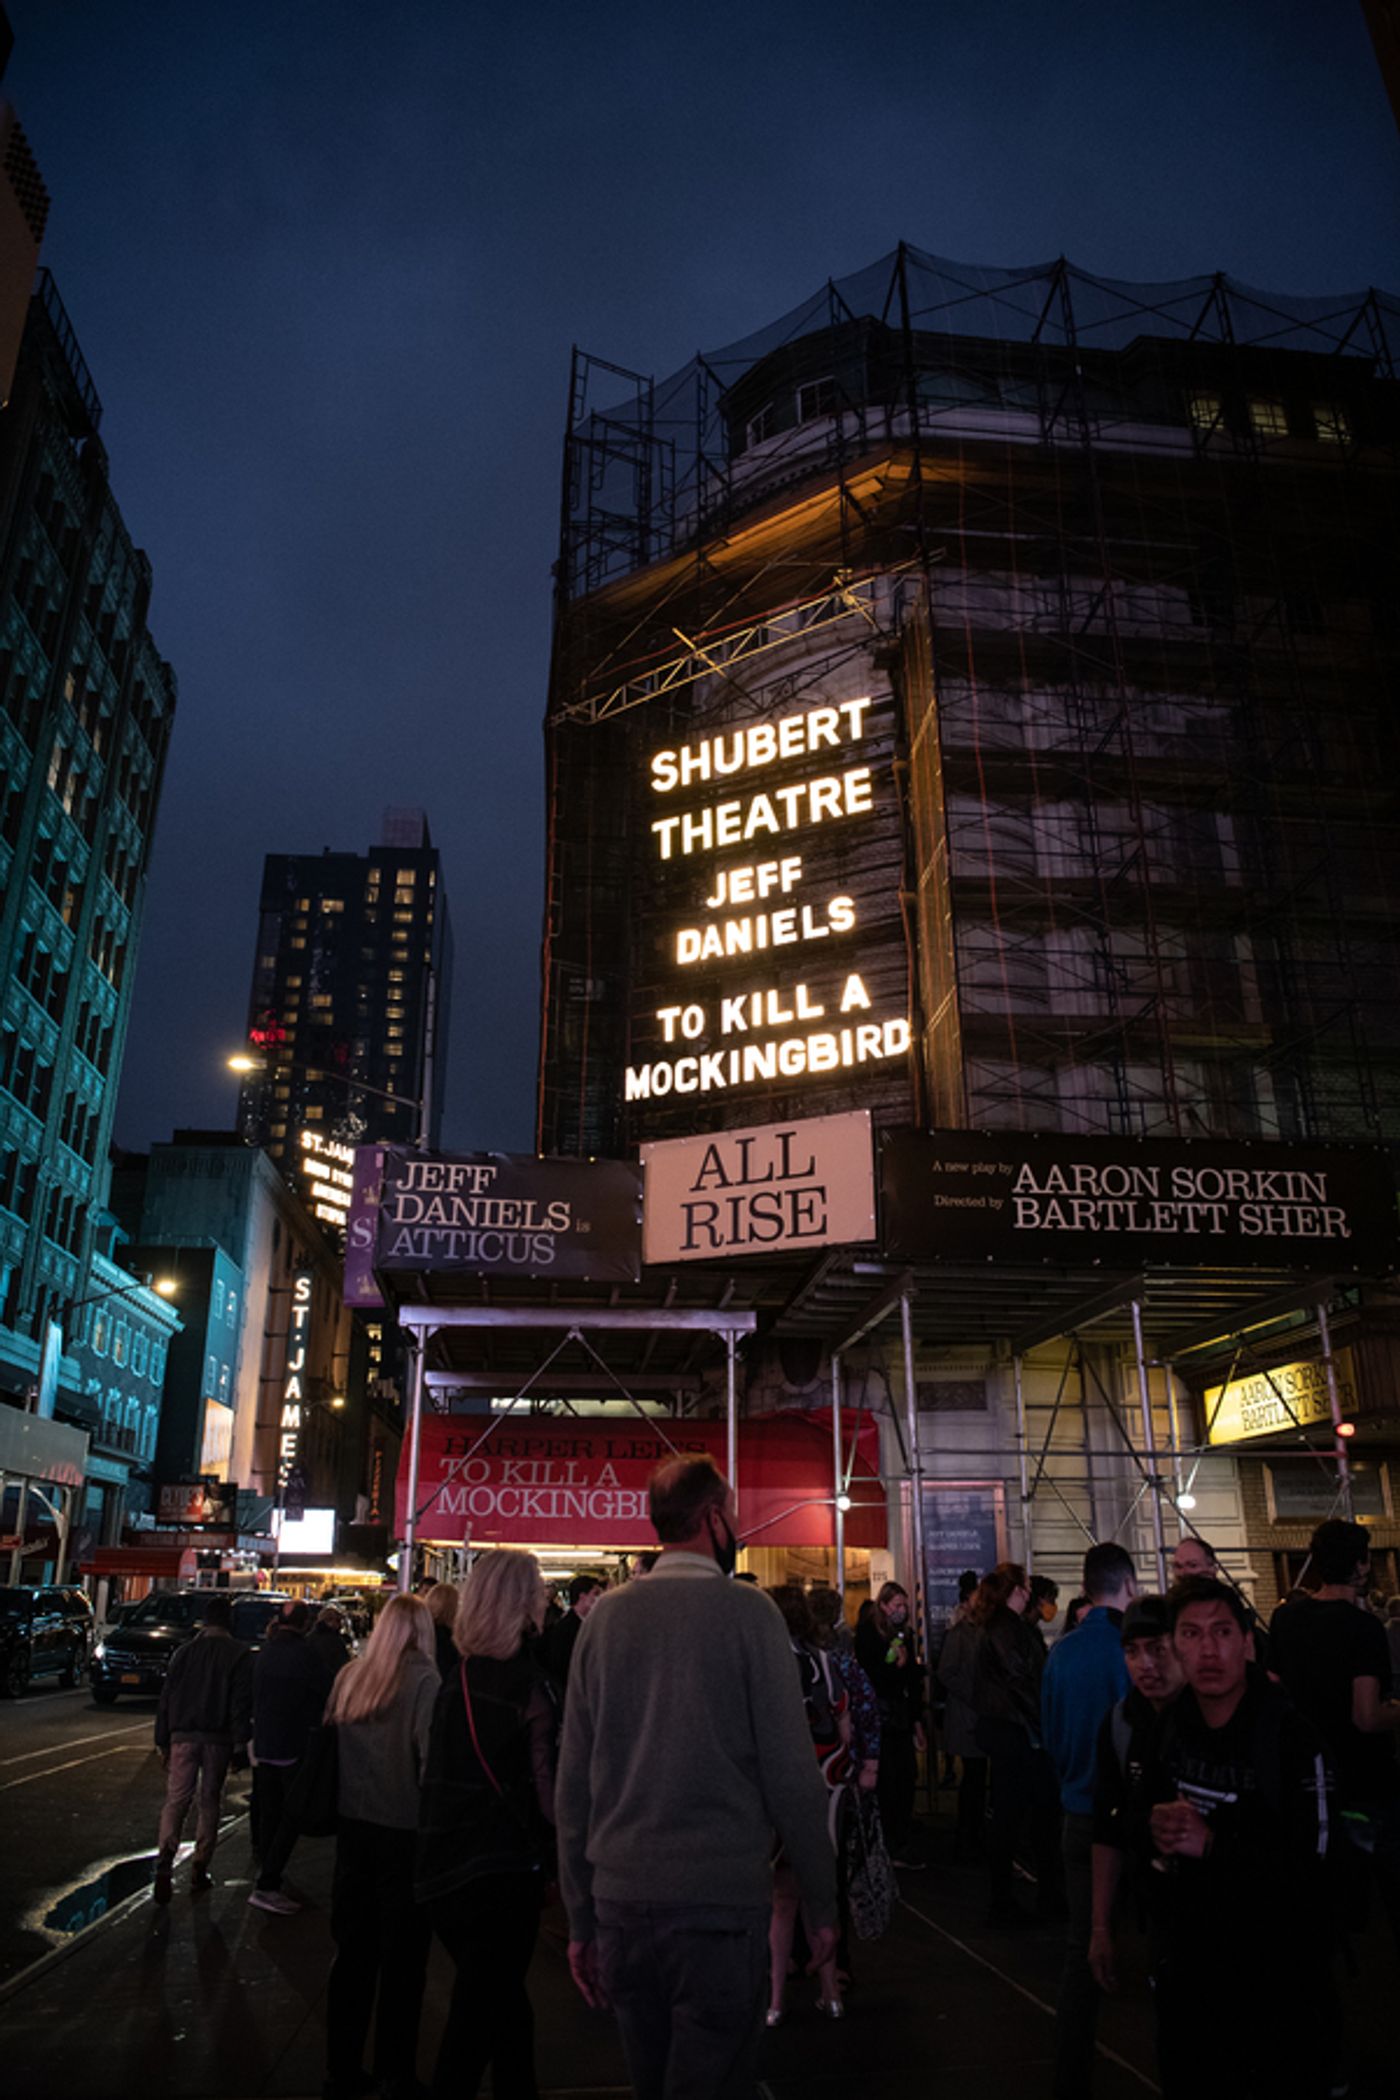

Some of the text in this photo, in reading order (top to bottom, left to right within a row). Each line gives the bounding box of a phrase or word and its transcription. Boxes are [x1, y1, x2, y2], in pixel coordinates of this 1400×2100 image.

[651, 697, 871, 792] SHUBERT
[651, 768, 873, 860] THEATRE
[706, 857, 802, 909] JEFF
[676, 896, 856, 965] DANIELS
[656, 974, 871, 1042] TO KILL A
[625, 1017, 912, 1101] MOCKINGBIRD
[396, 1162, 497, 1194] JEFF
[689, 1131, 815, 1192] ALL
[931, 1159, 1327, 1203] A new play by AARON SORKIN
[392, 1194, 590, 1232] DANIELS is
[680, 1185, 827, 1250] RISE
[933, 1194, 1351, 1239] Directed by BARTLETT SHER
[388, 1227, 555, 1265] ATTICUS
[441, 1436, 593, 1459] HARPER
[438, 1458, 621, 1487] TO KILL A
[436, 1486, 651, 1520] MOCKINGBI
